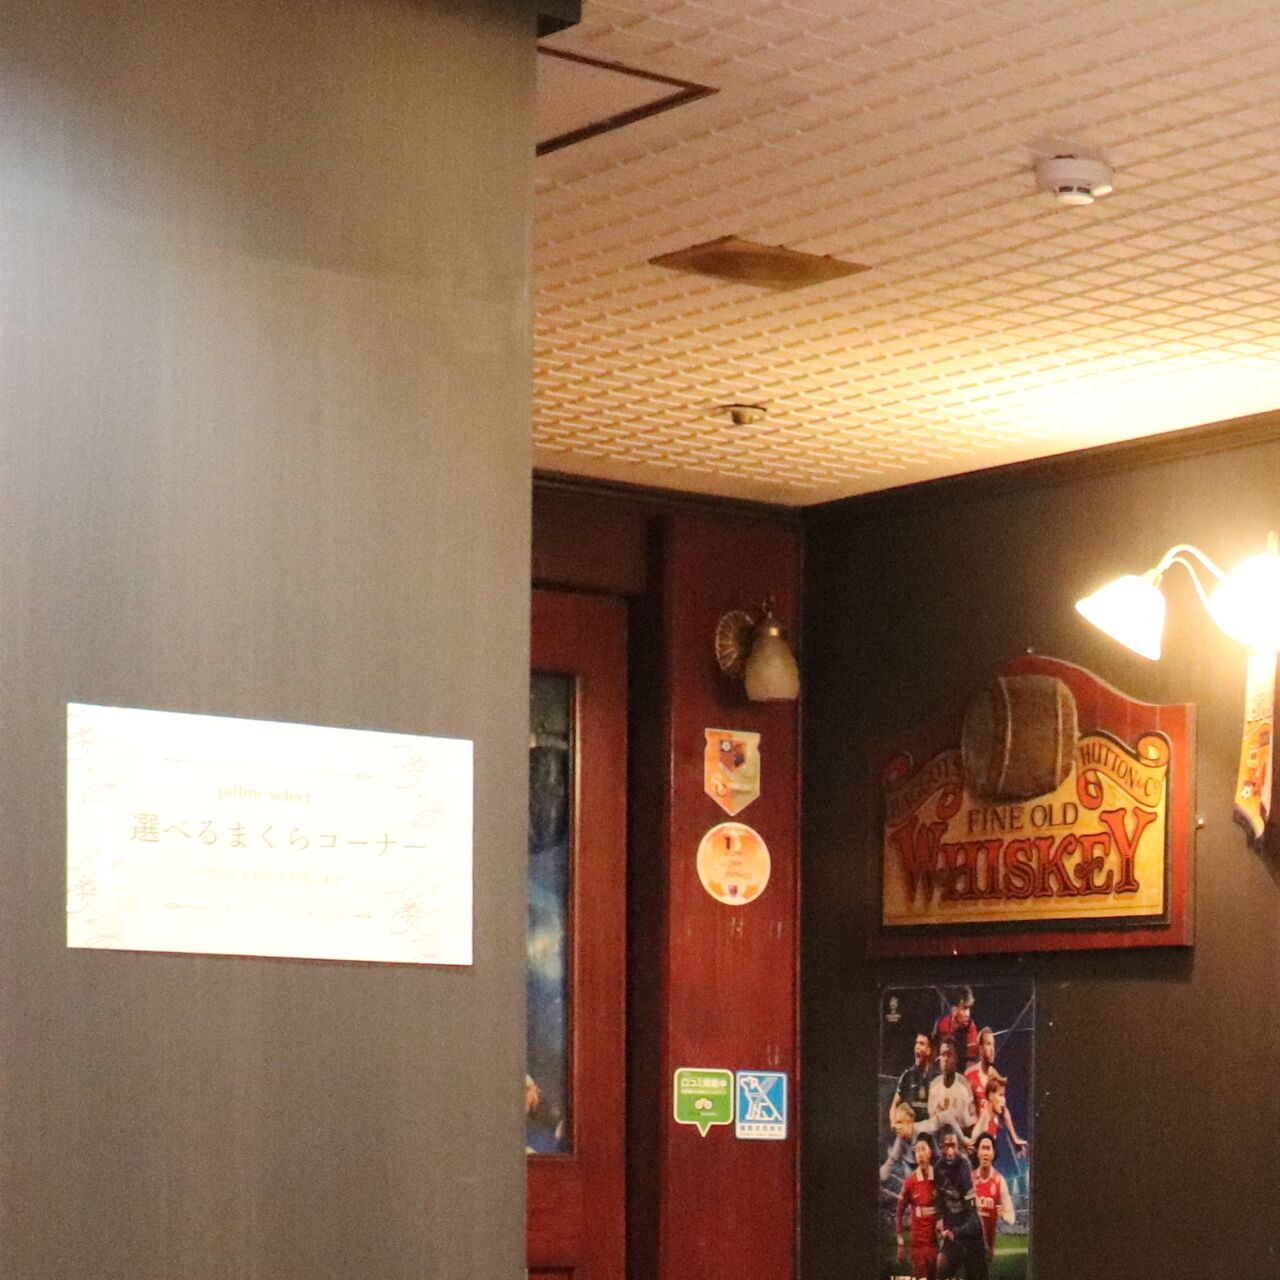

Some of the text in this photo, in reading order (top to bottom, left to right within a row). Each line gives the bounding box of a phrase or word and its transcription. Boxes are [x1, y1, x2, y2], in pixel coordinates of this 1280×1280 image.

[1080, 741, 1137, 790] HUTTON
[217, 783, 312, 803] pillow select
[129, 811, 427, 857] 選べるまくらコーナー
[967, 802, 1079, 833] FINE OLD
[887, 807, 1159, 913] WHISKEY
